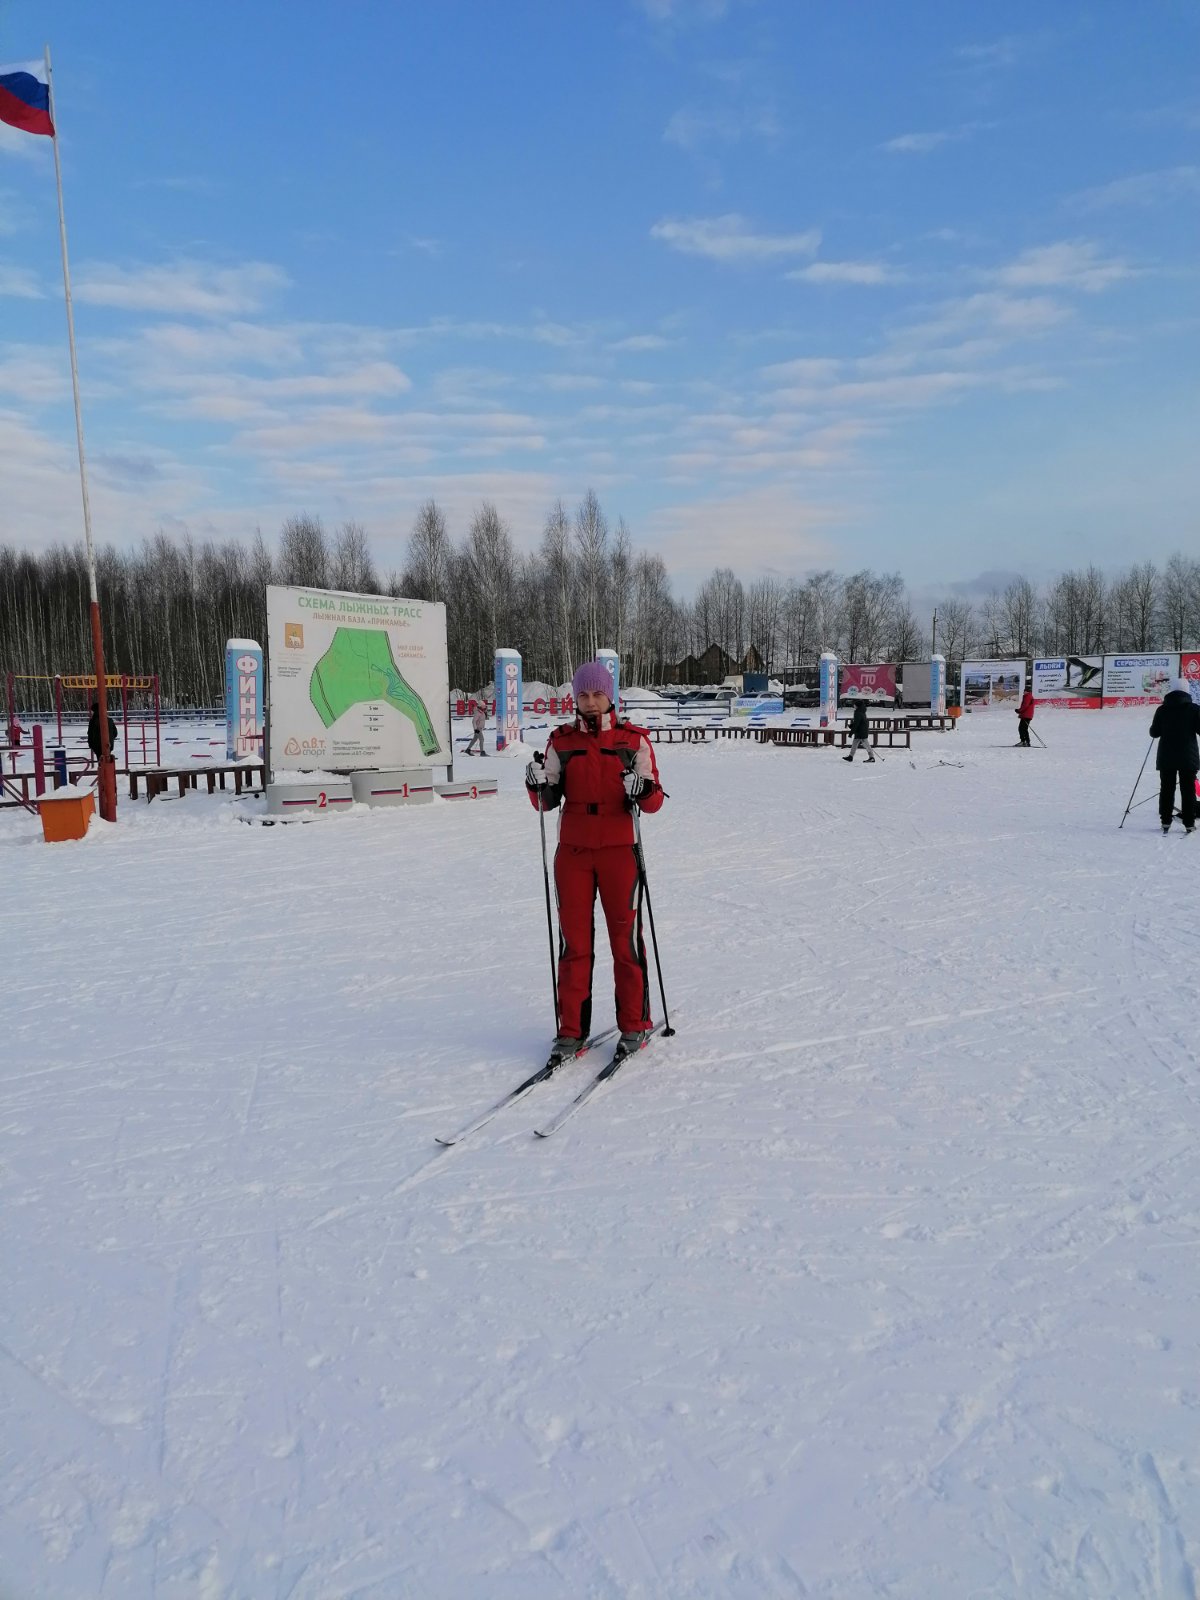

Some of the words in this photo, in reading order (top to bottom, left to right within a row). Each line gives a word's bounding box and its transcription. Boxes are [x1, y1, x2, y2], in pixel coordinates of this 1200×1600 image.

[298, 596, 336, 611] СХЕМА
[339, 601, 389, 615] ЛЫЖНЫХ
[392, 606, 423, 618] ТРАСС
[312, 612, 345, 622] ЛЫЖНАЯ
[347, 616, 366, 624] БАЗА
[859, 673, 876, 685] ГТО
[236, 655, 260, 757] ФИНИШ
[505, 662, 520, 744] ФИНИШ
[302, 749, 326, 757] спорт
[401, 782, 409, 798] 1
[470, 785, 478, 800] 3
[318, 791, 327, 808] 2
